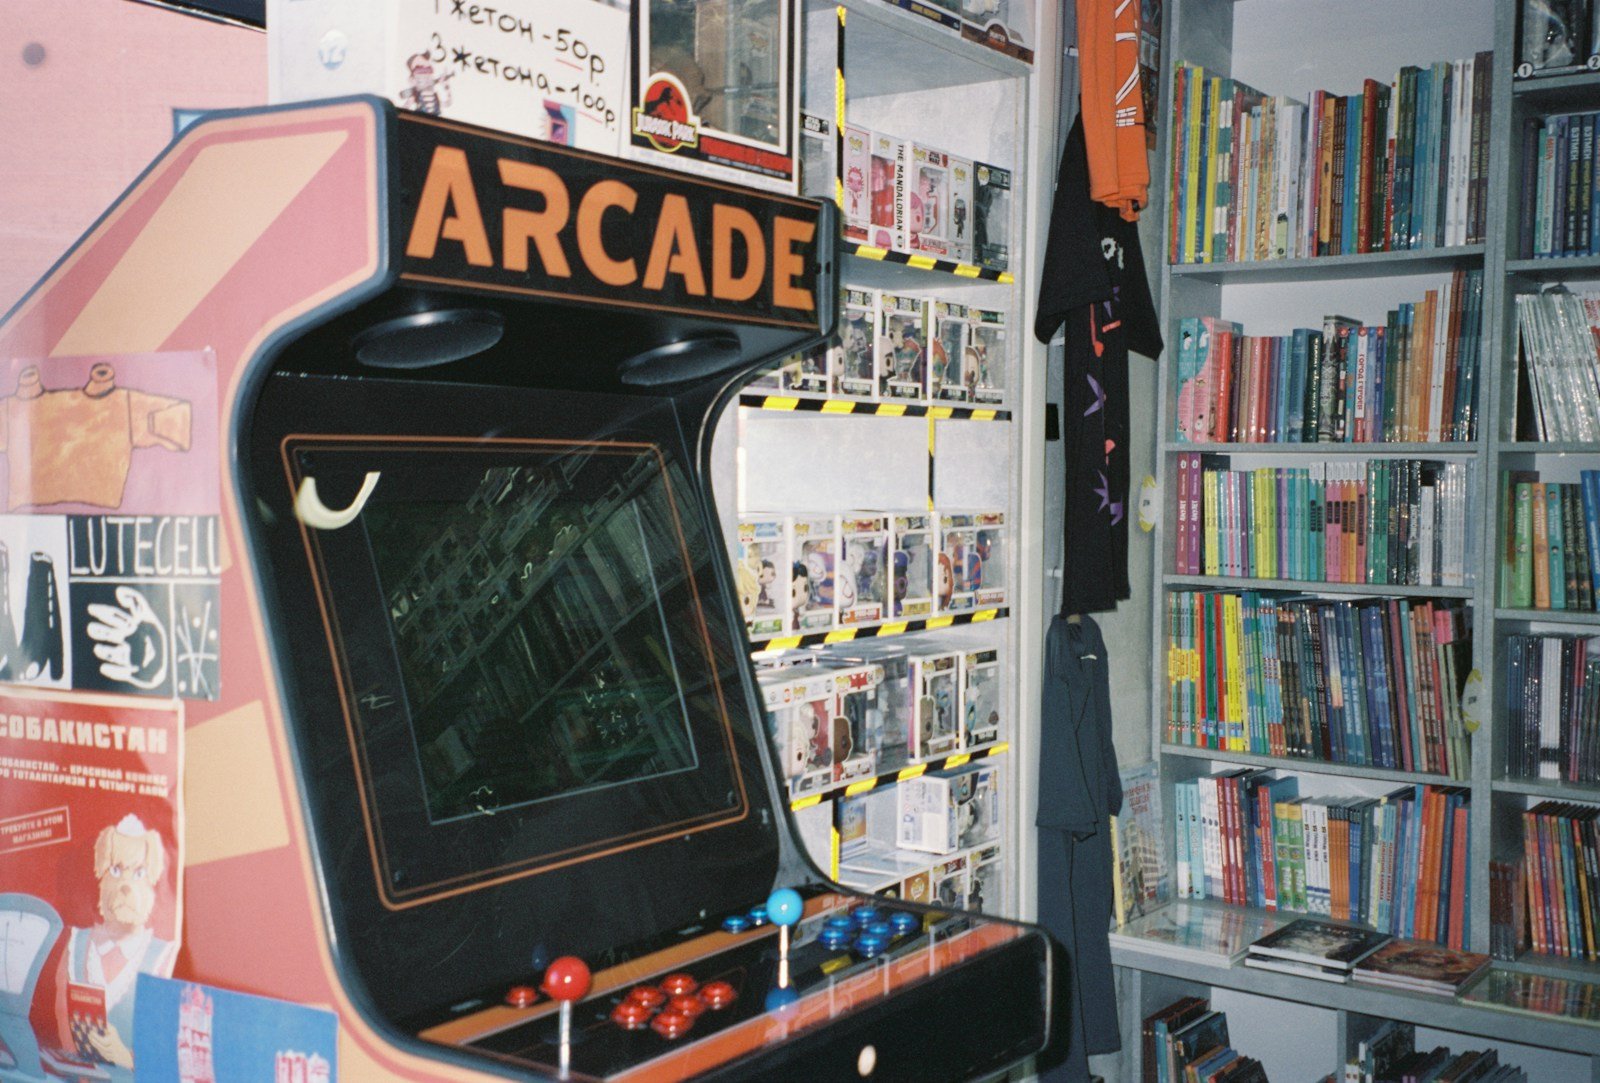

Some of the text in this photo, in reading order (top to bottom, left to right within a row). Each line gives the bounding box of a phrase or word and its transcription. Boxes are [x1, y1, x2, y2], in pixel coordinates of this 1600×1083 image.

[431, 31, 446, 63] 3
[1570, 126, 1580, 161] БЭТМЕН
[1583, 125, 1593, 160] БЭТМЕН
[896, 164, 904, 232] MANDALORIAN
[405, 144, 817, 312] ARCADE
